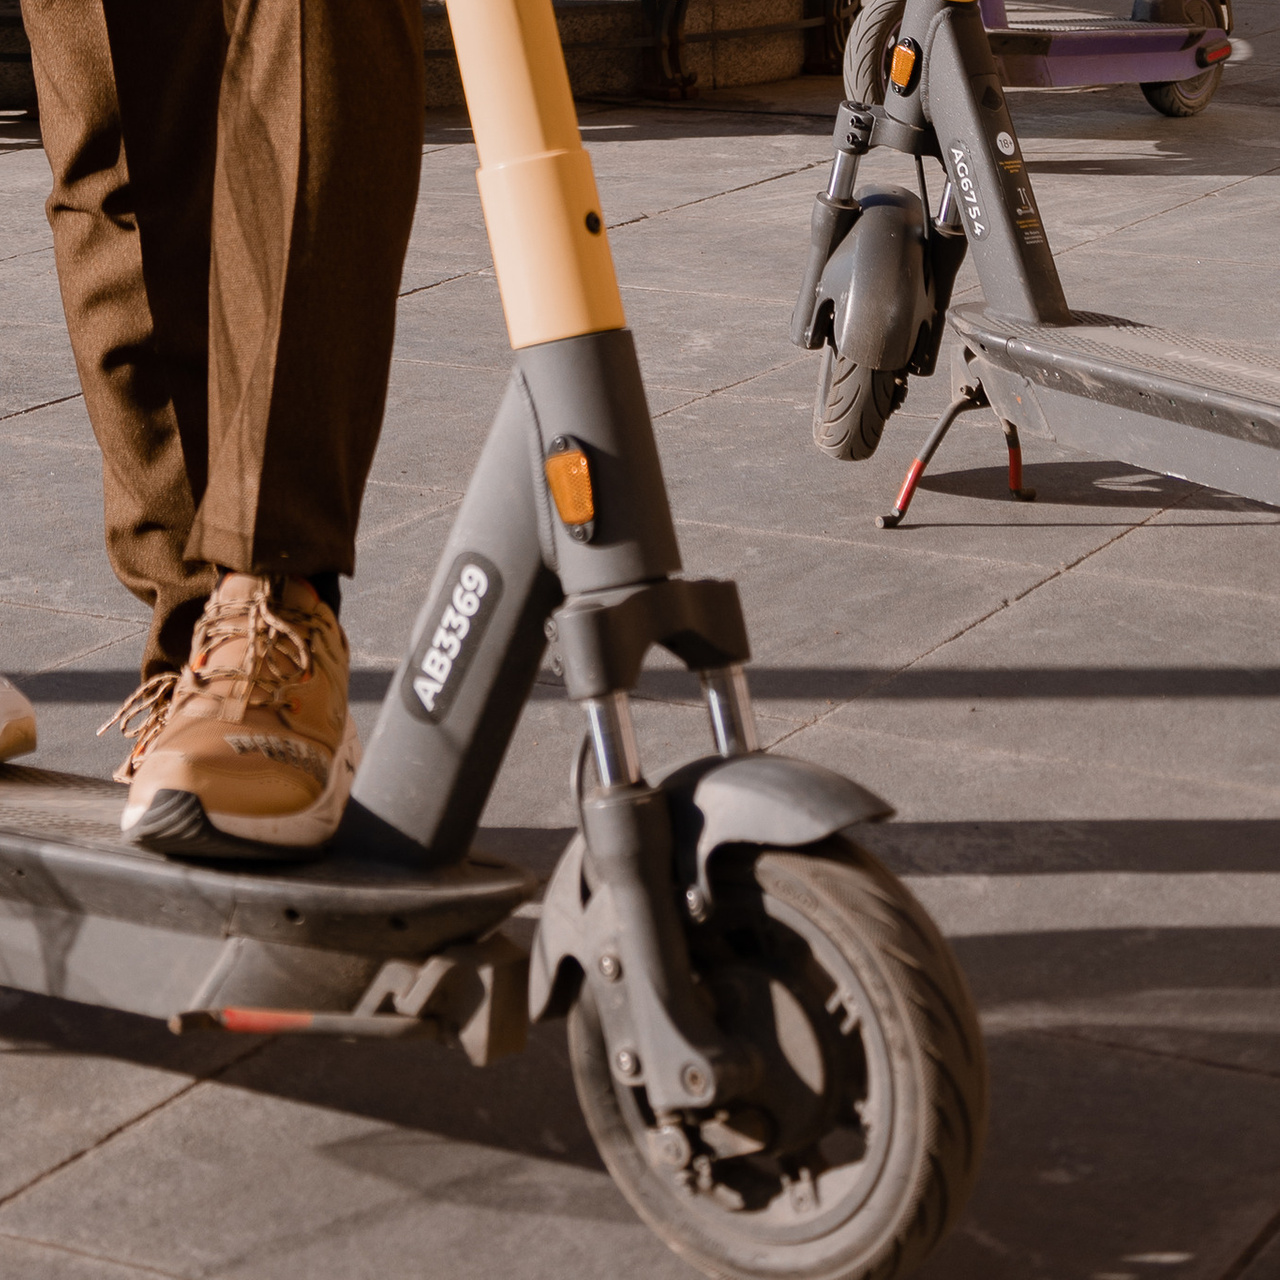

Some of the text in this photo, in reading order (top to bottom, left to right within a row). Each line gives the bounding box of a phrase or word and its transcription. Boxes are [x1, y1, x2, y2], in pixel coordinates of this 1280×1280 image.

[999, 138, 1013, 150] 18+
[951, 148, 985, 236] AG6754
[413, 564, 489, 712] AB3369
